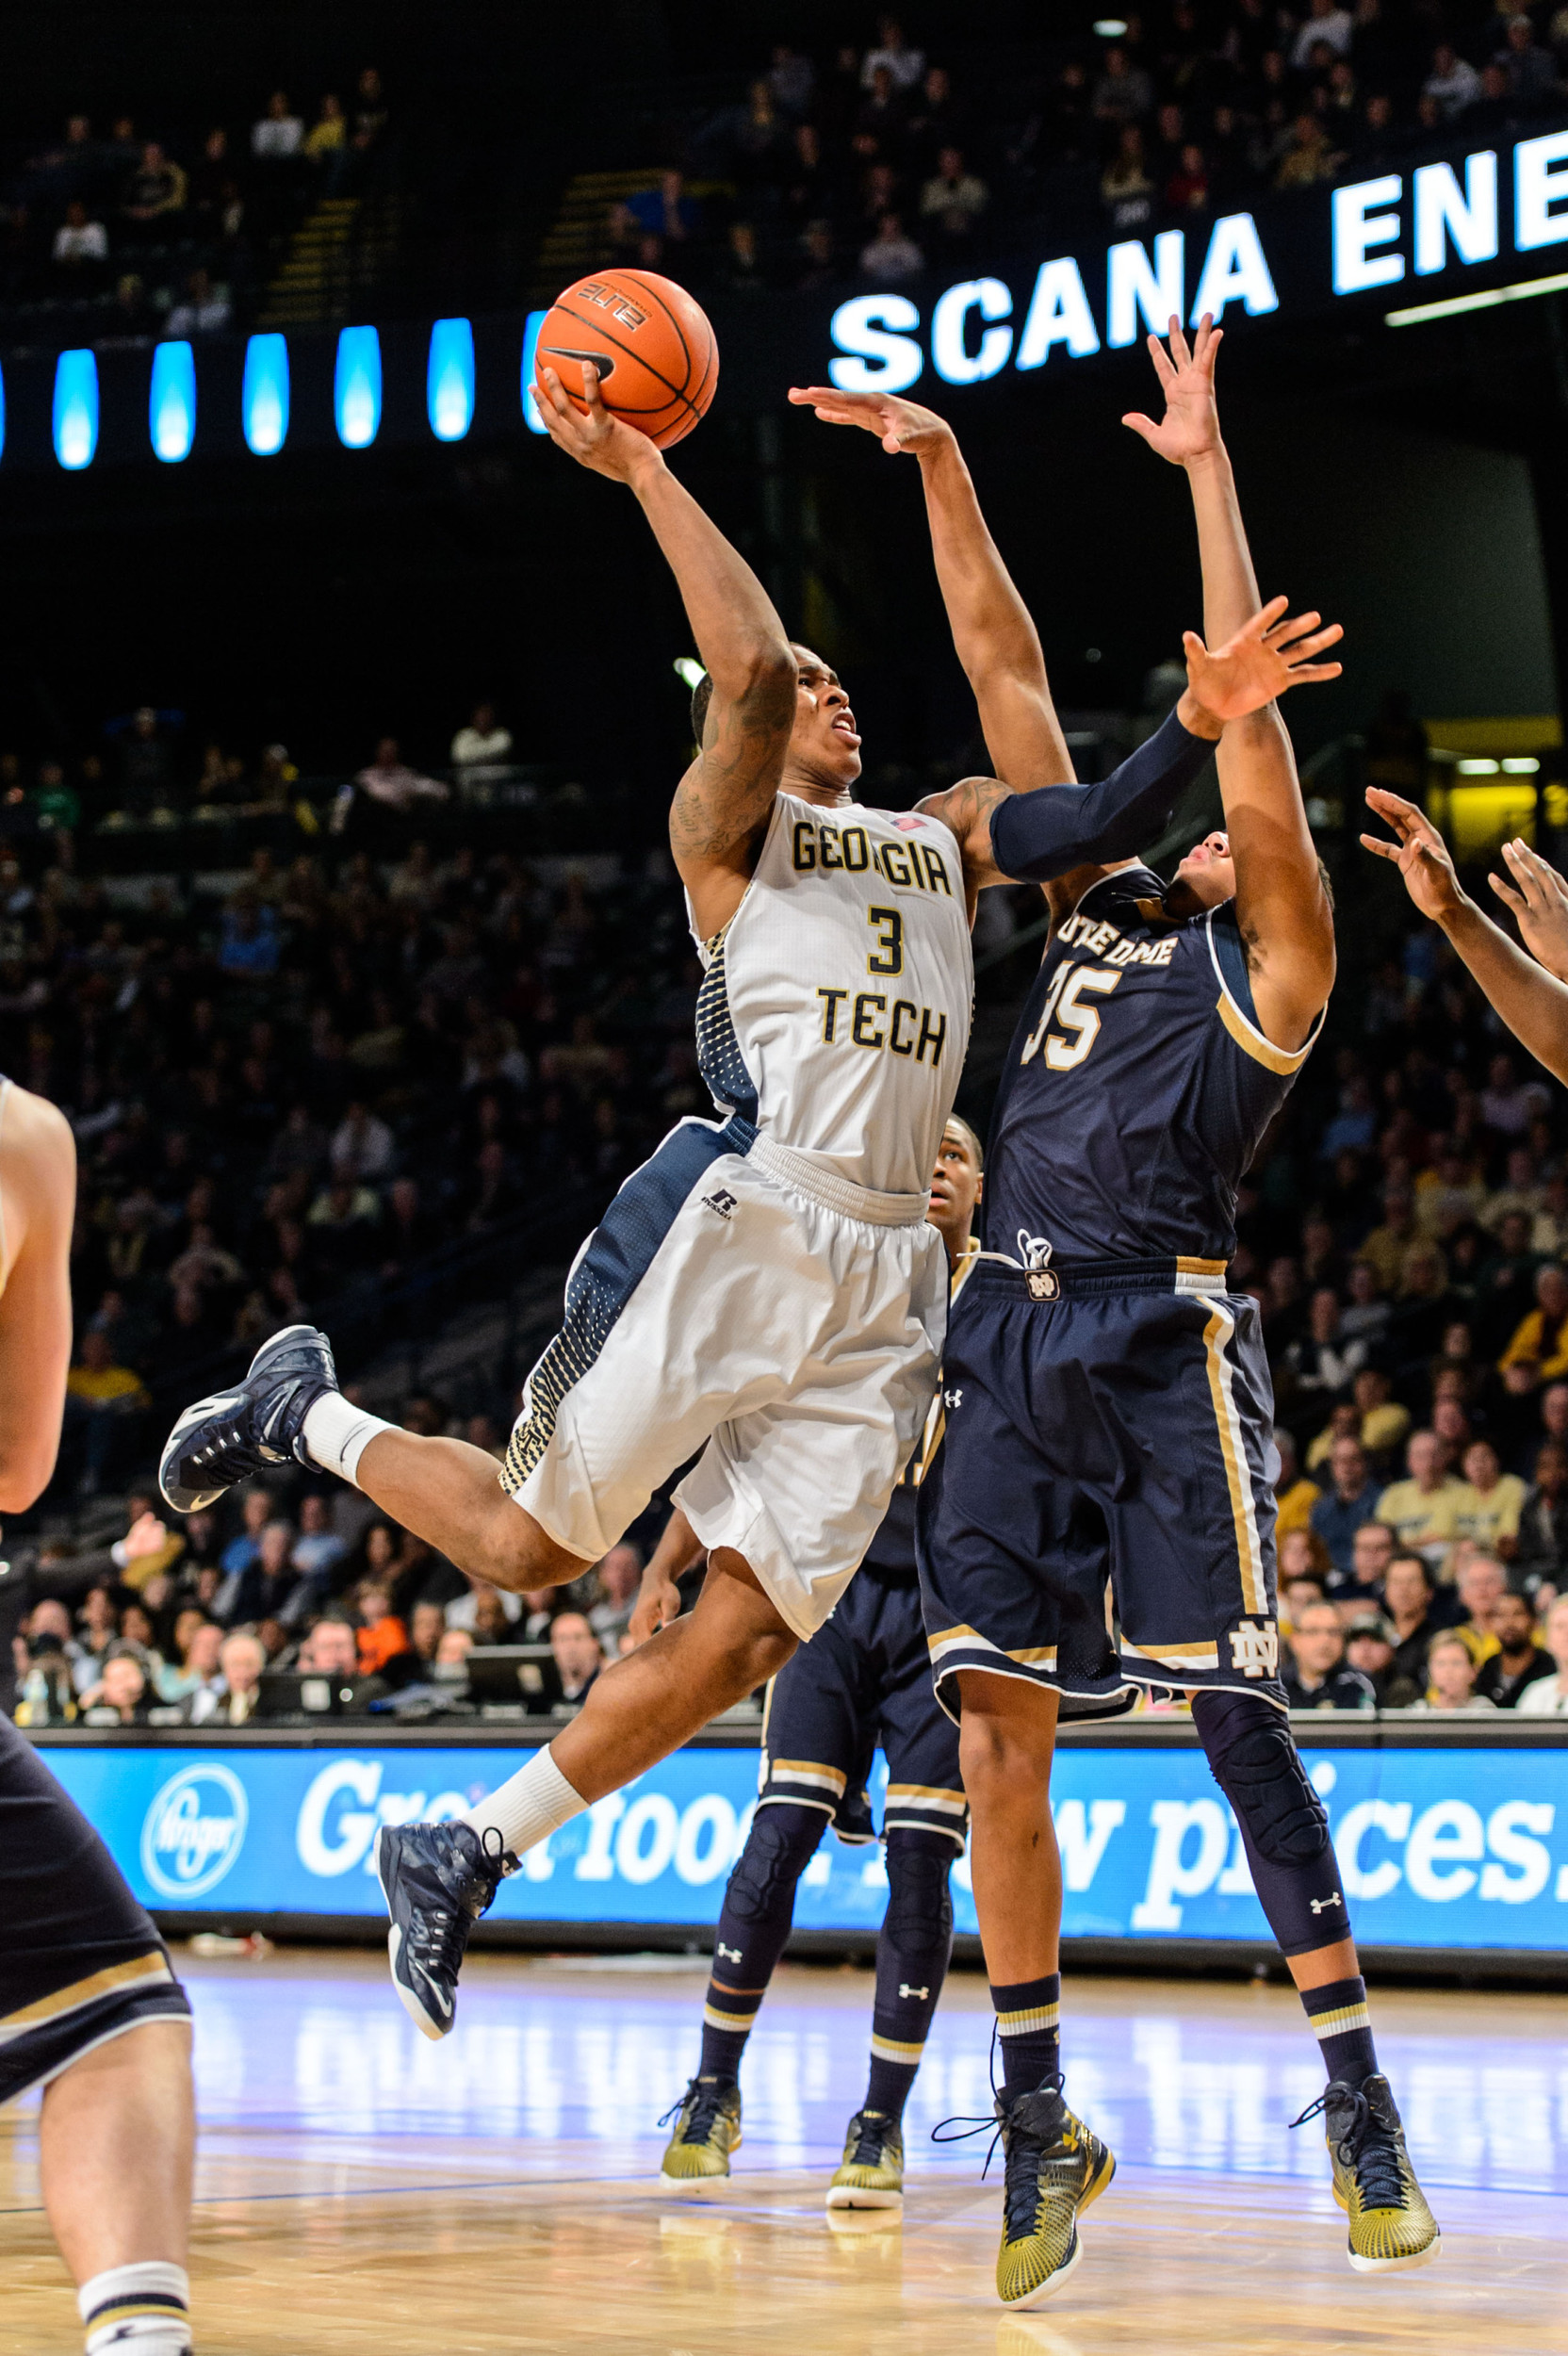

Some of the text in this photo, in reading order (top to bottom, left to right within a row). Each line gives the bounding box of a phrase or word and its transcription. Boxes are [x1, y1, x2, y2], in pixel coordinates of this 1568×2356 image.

[577, 283, 648, 333] ELITE
[828, 211, 1280, 394] SCANA
[792, 820, 953, 896] GEOGIA
[867, 904, 905, 978] 3
[1102, 937, 1179, 967] DME
[815, 987, 947, 1069] TECH
